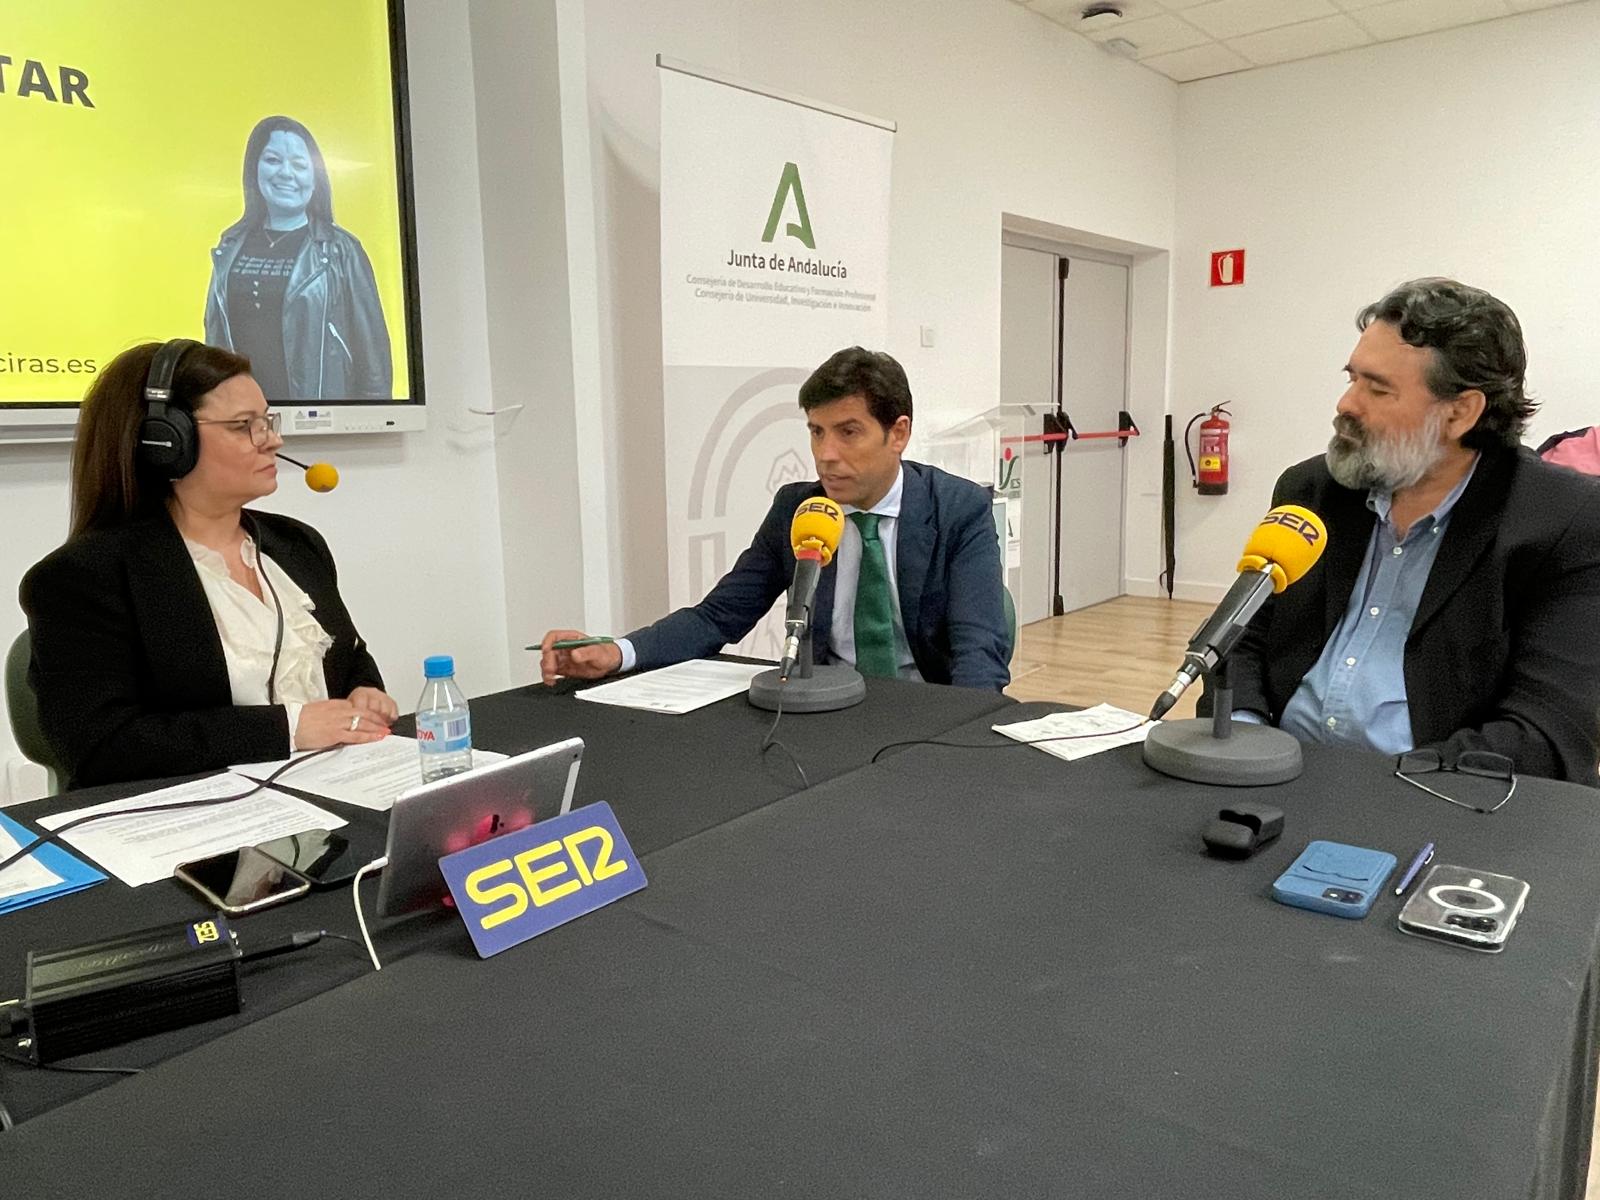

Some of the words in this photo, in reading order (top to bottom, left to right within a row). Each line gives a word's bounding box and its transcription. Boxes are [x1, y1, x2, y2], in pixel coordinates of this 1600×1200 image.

[727, 249, 766, 269] Junta
[769, 253, 785, 271] de
[788, 256, 847, 279] Andalucía
[795, 502, 839, 521] SER
[1259, 512, 1320, 547] SER
[465, 826, 629, 931] SER
